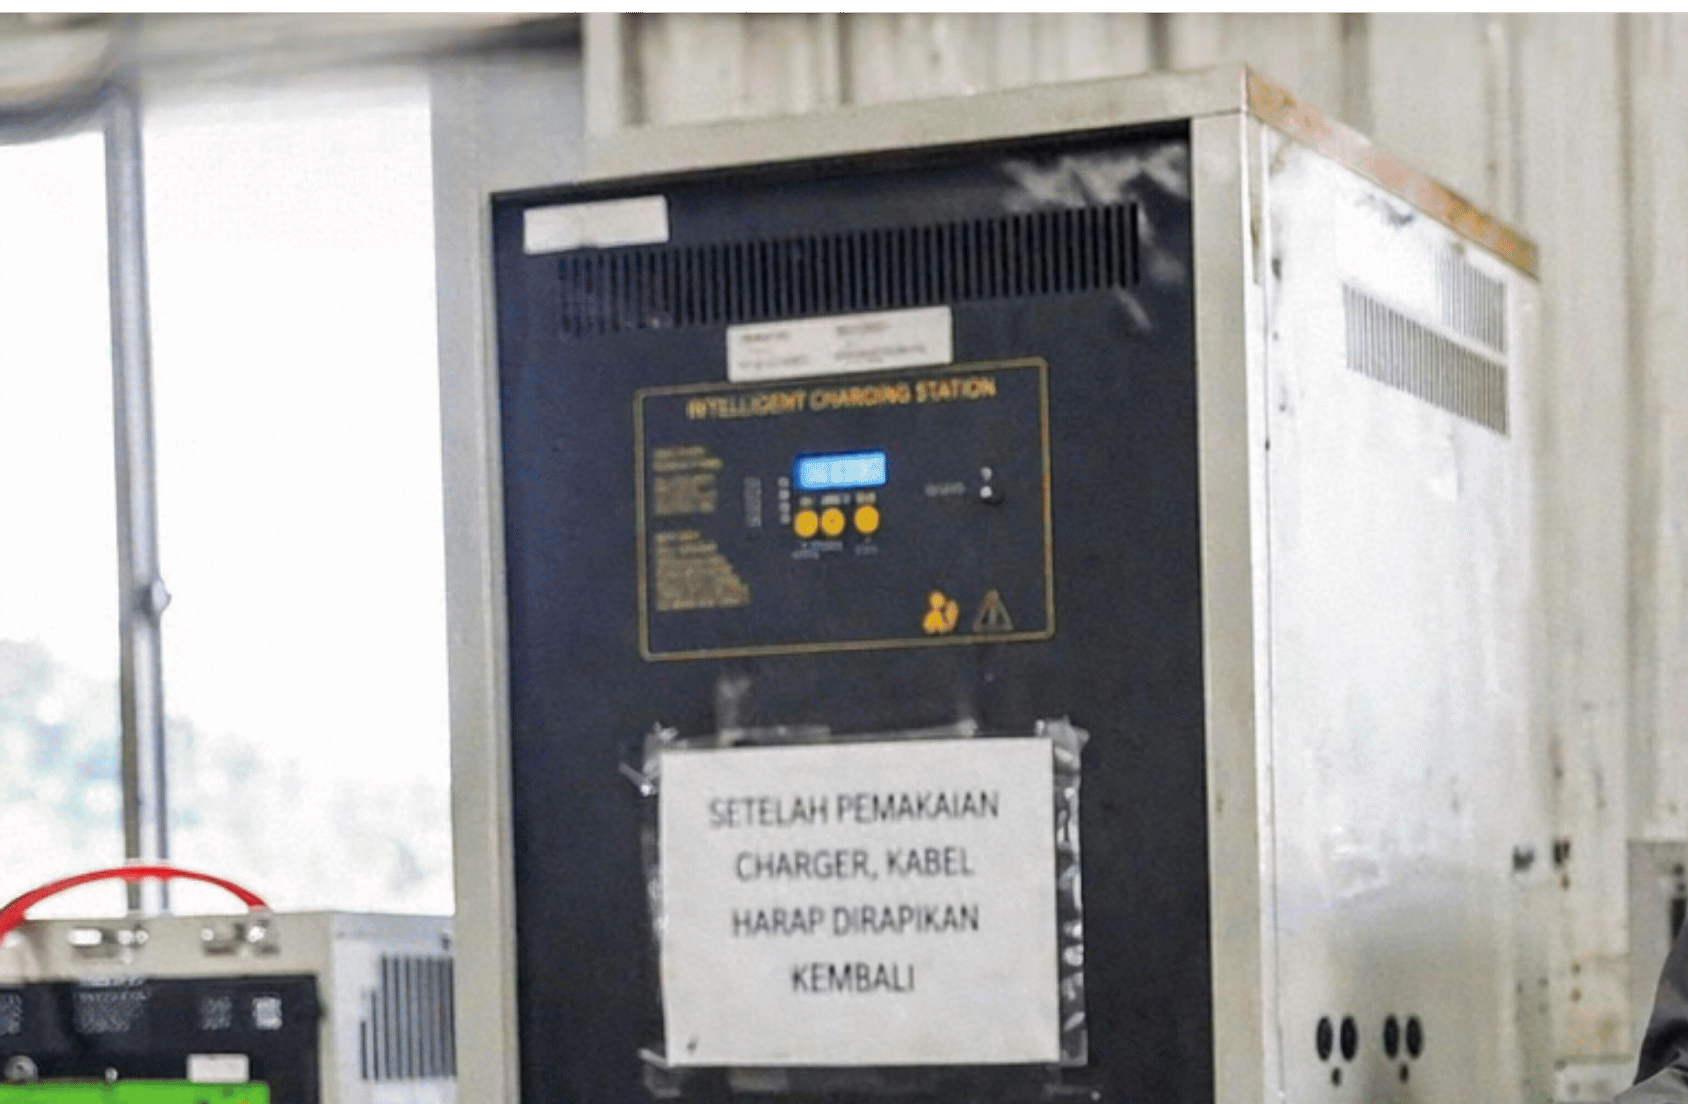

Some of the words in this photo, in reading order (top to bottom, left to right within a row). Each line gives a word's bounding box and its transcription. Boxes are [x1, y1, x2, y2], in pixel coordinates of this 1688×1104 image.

[915, 377, 996, 404] STATION
[708, 796, 828, 829] SETELAH
[836, 790, 1000, 824] PEMAKAIAN
[735, 848, 879, 882] CHARGER,
[886, 846, 976, 877] KABEL
[731, 907, 825, 938] HARAP
[832, 904, 980, 937] DIRAPIKAN
[791, 962, 915, 994] KEMBALI
